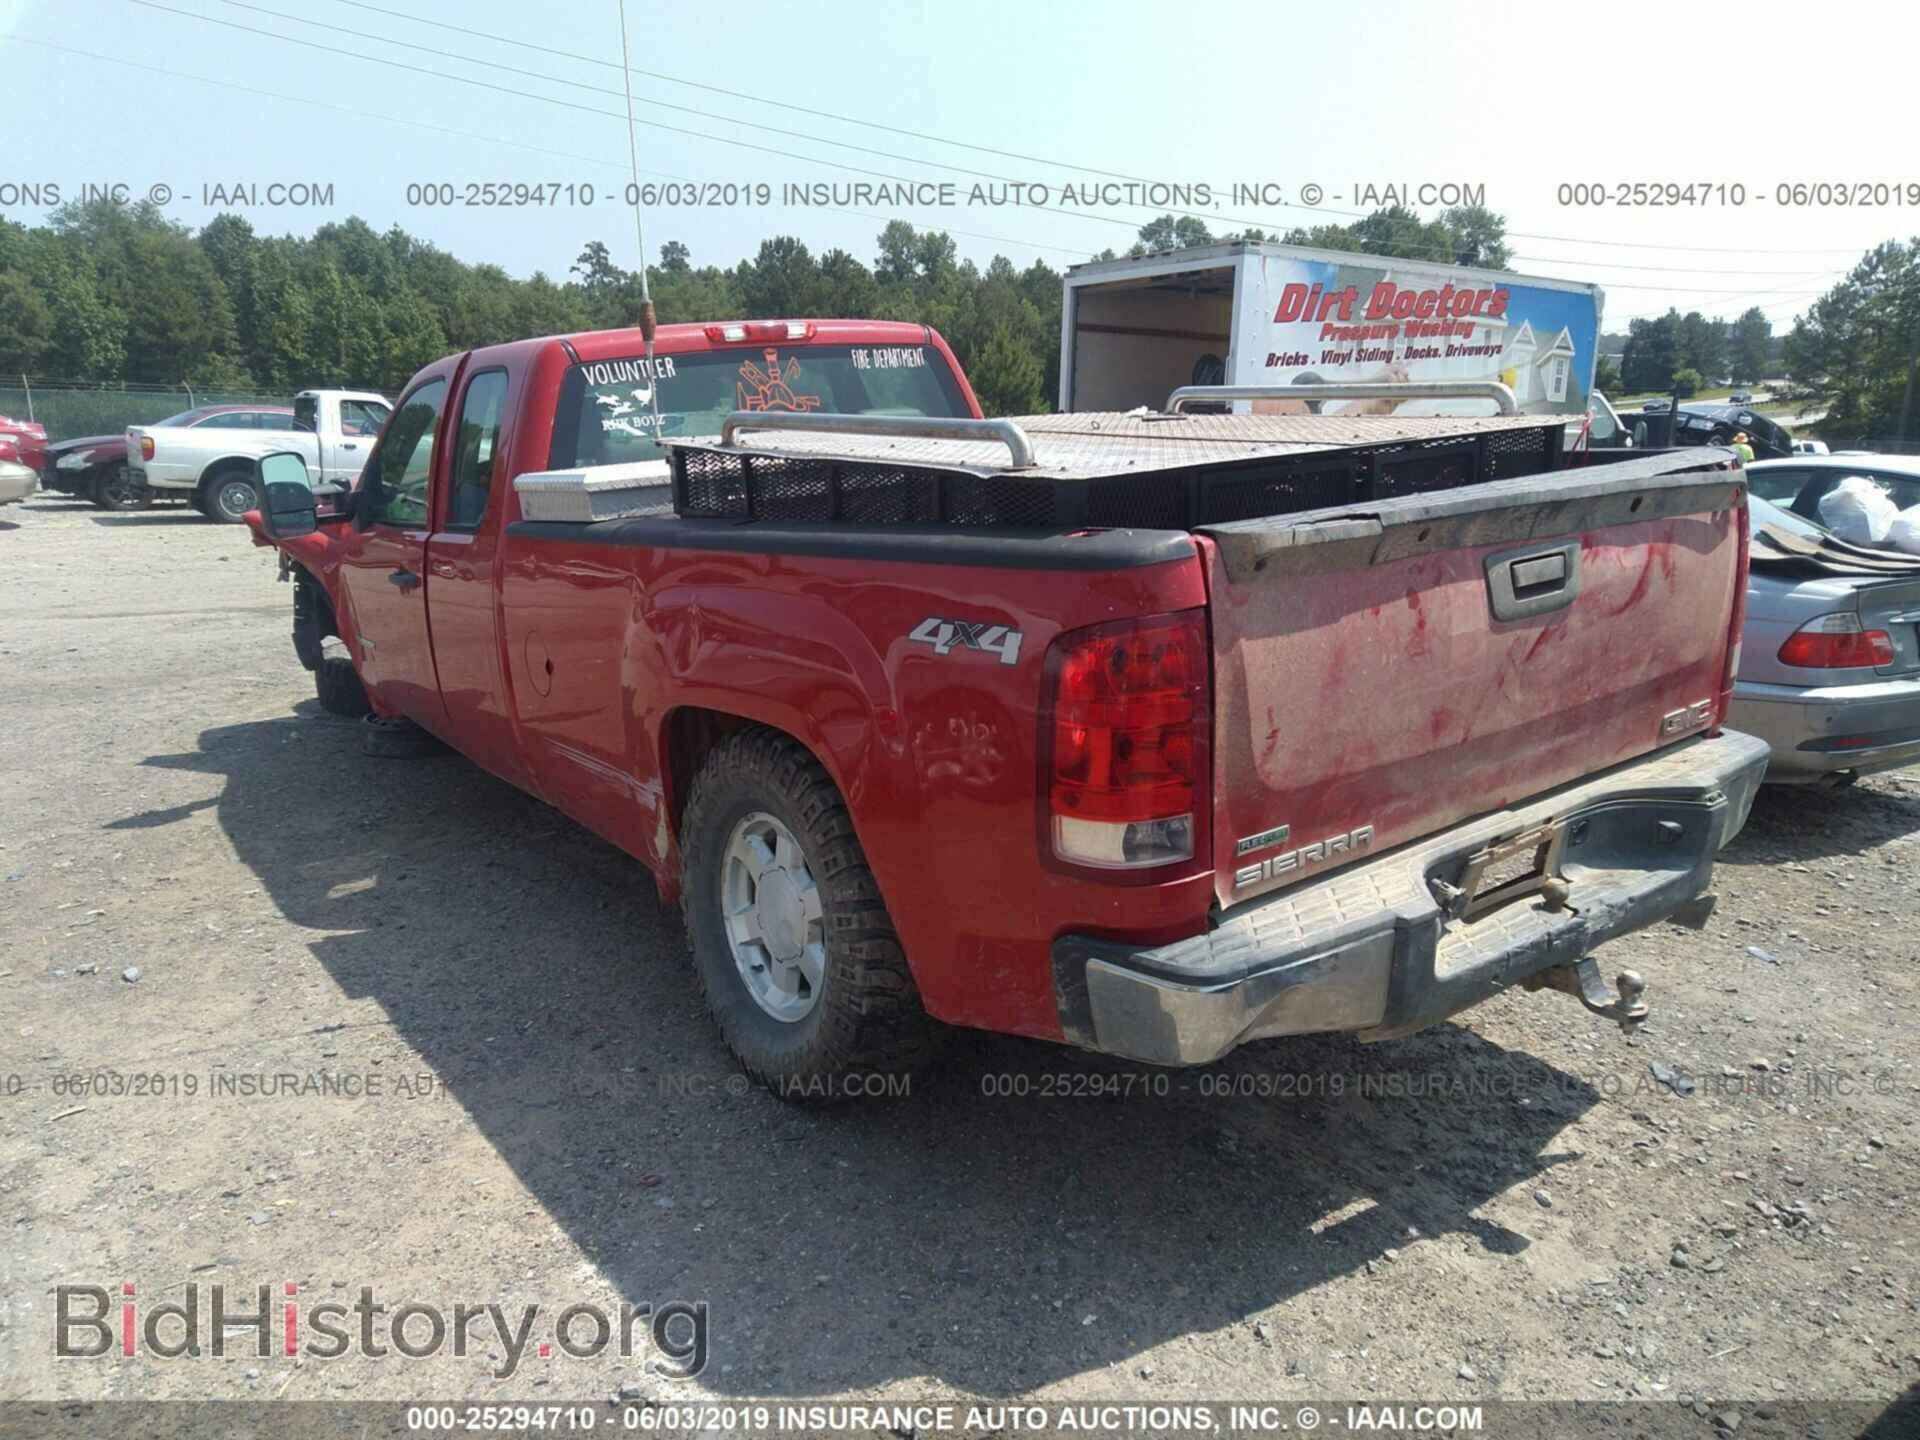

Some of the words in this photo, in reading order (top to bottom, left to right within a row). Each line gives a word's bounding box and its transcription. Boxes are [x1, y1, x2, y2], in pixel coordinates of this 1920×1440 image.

[1273, 282, 1358, 323] Dirt
[1364, 282, 1510, 319] Doctors
[1318, 322, 1399, 342] Pressure
[1404, 319, 1476, 339] Washing
[851, 348, 871, 369] FIRE
[872, 347, 925, 369] DEPARTMENT
[1265, 351, 1309, 367] Bricks
[1321, 348, 1353, 366] Vinyl
[1355, 347, 1394, 364] Siding
[1445, 343, 1503, 358] Driveways
[581, 357, 677, 387] VOLUNTEER
[1659, 698, 1712, 736] GMC
[1235, 824, 1375, 889] SIERRA
